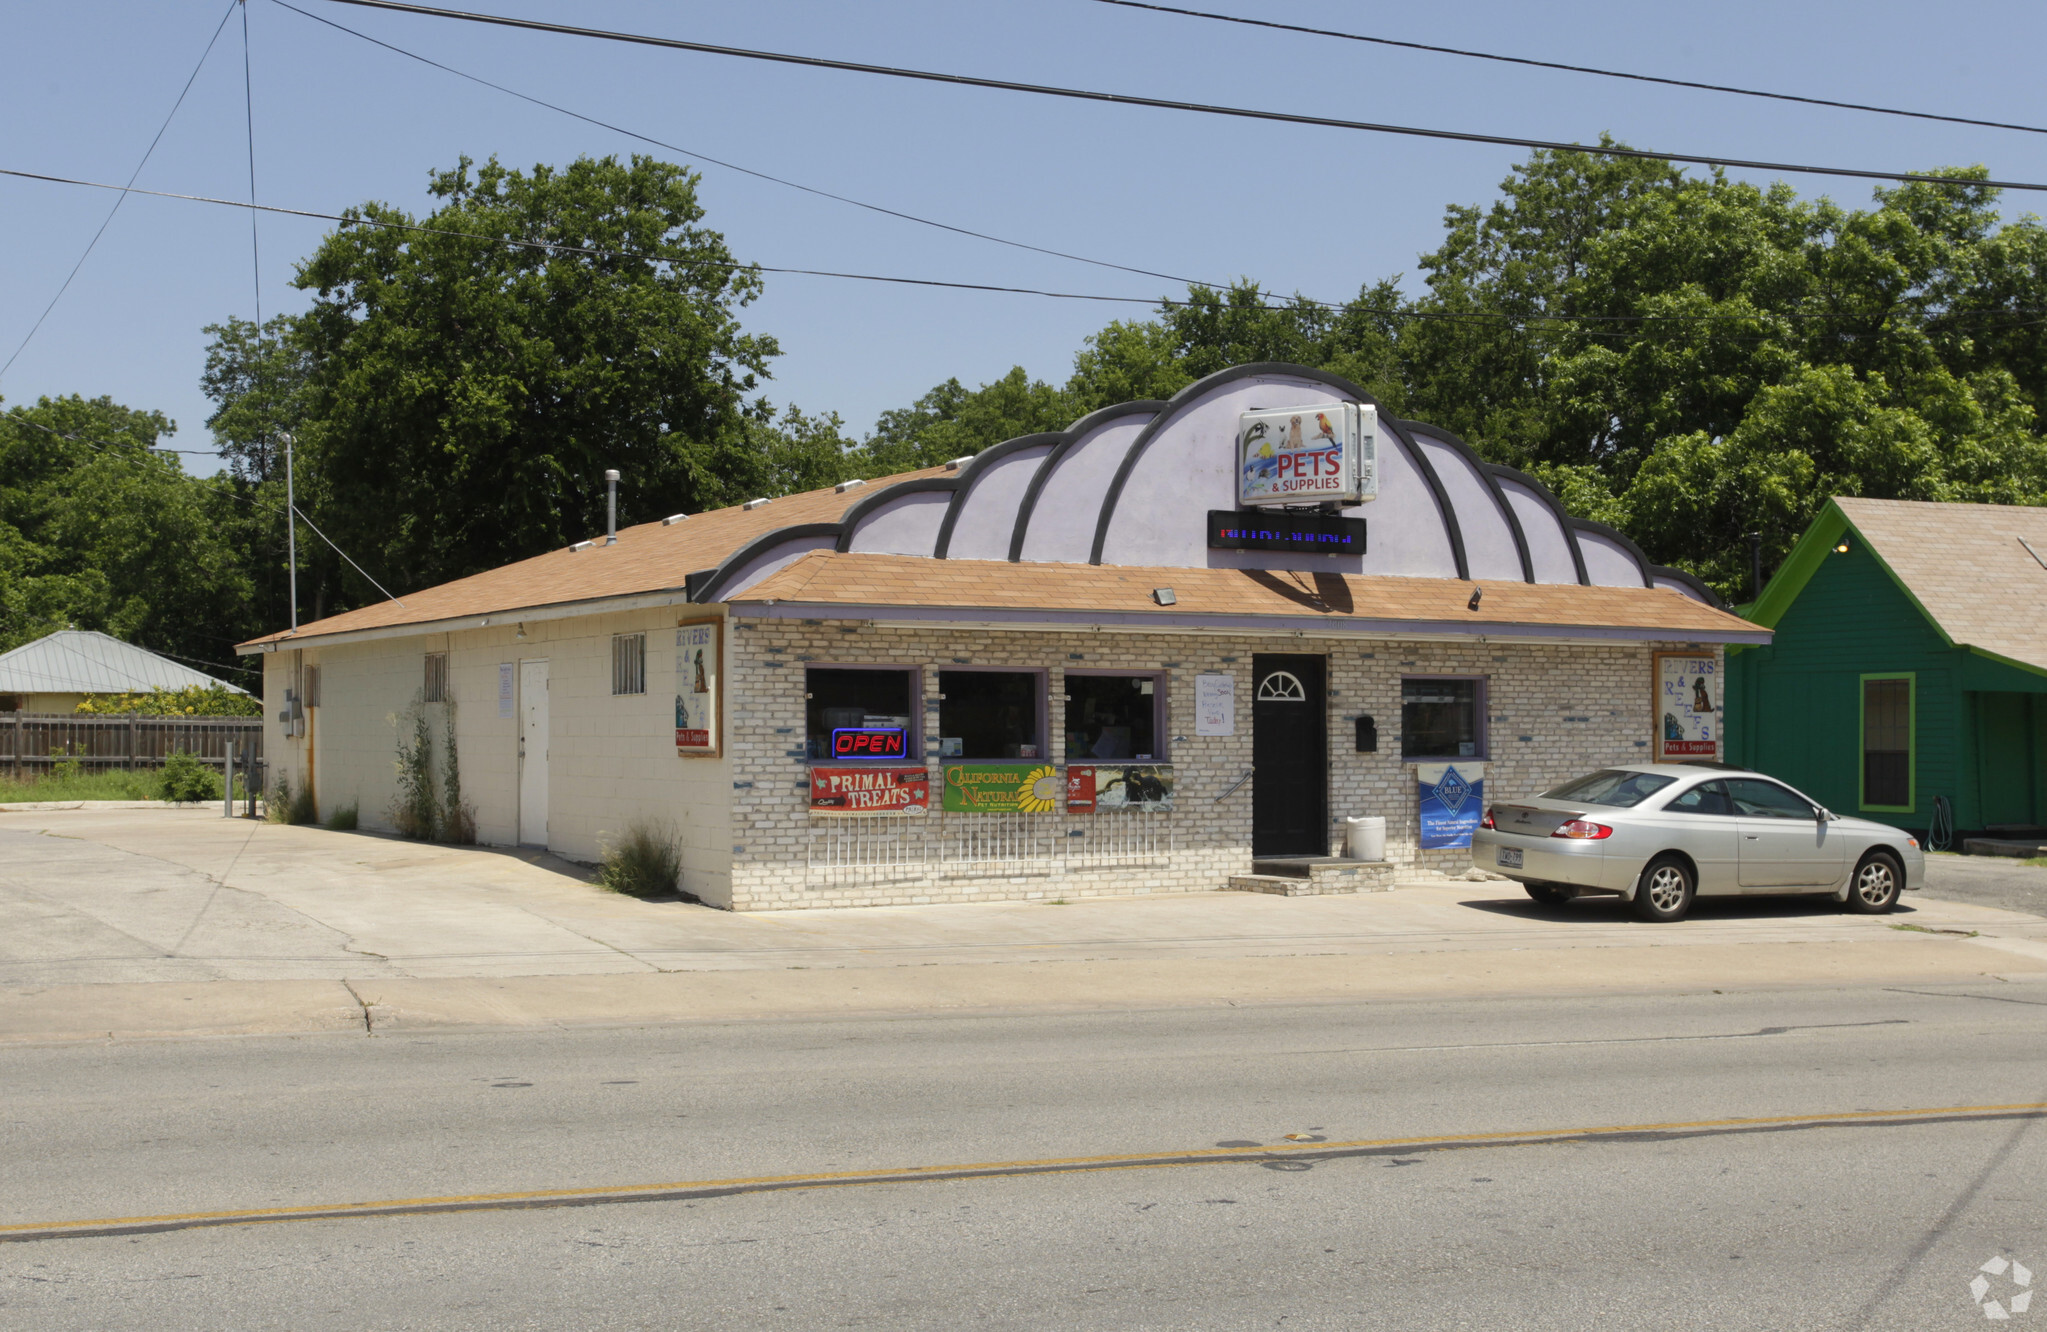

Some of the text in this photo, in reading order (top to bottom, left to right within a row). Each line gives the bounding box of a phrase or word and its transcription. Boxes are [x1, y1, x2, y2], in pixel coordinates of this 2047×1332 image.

[1278, 450, 1340, 478] PETS
[1272, 477, 1340, 493] & SUPPLIES
[676, 627, 710, 647] RIVERS
[1664, 659, 1714, 675] RIVERS
[1677, 675, 1686, 688] &
[836, 735, 902, 752] OPEN
[1665, 742, 1679, 751] Pets
[1689, 742, 1714, 753] Supplies
[829, 772, 896, 793] PRIMAL
[947, 765, 1021, 787] CALIFORNIA
[848, 787, 910, 809] TREATS
[960, 786, 1021, 807] NATURAL
[1444, 785, 1462, 794] BLUE
